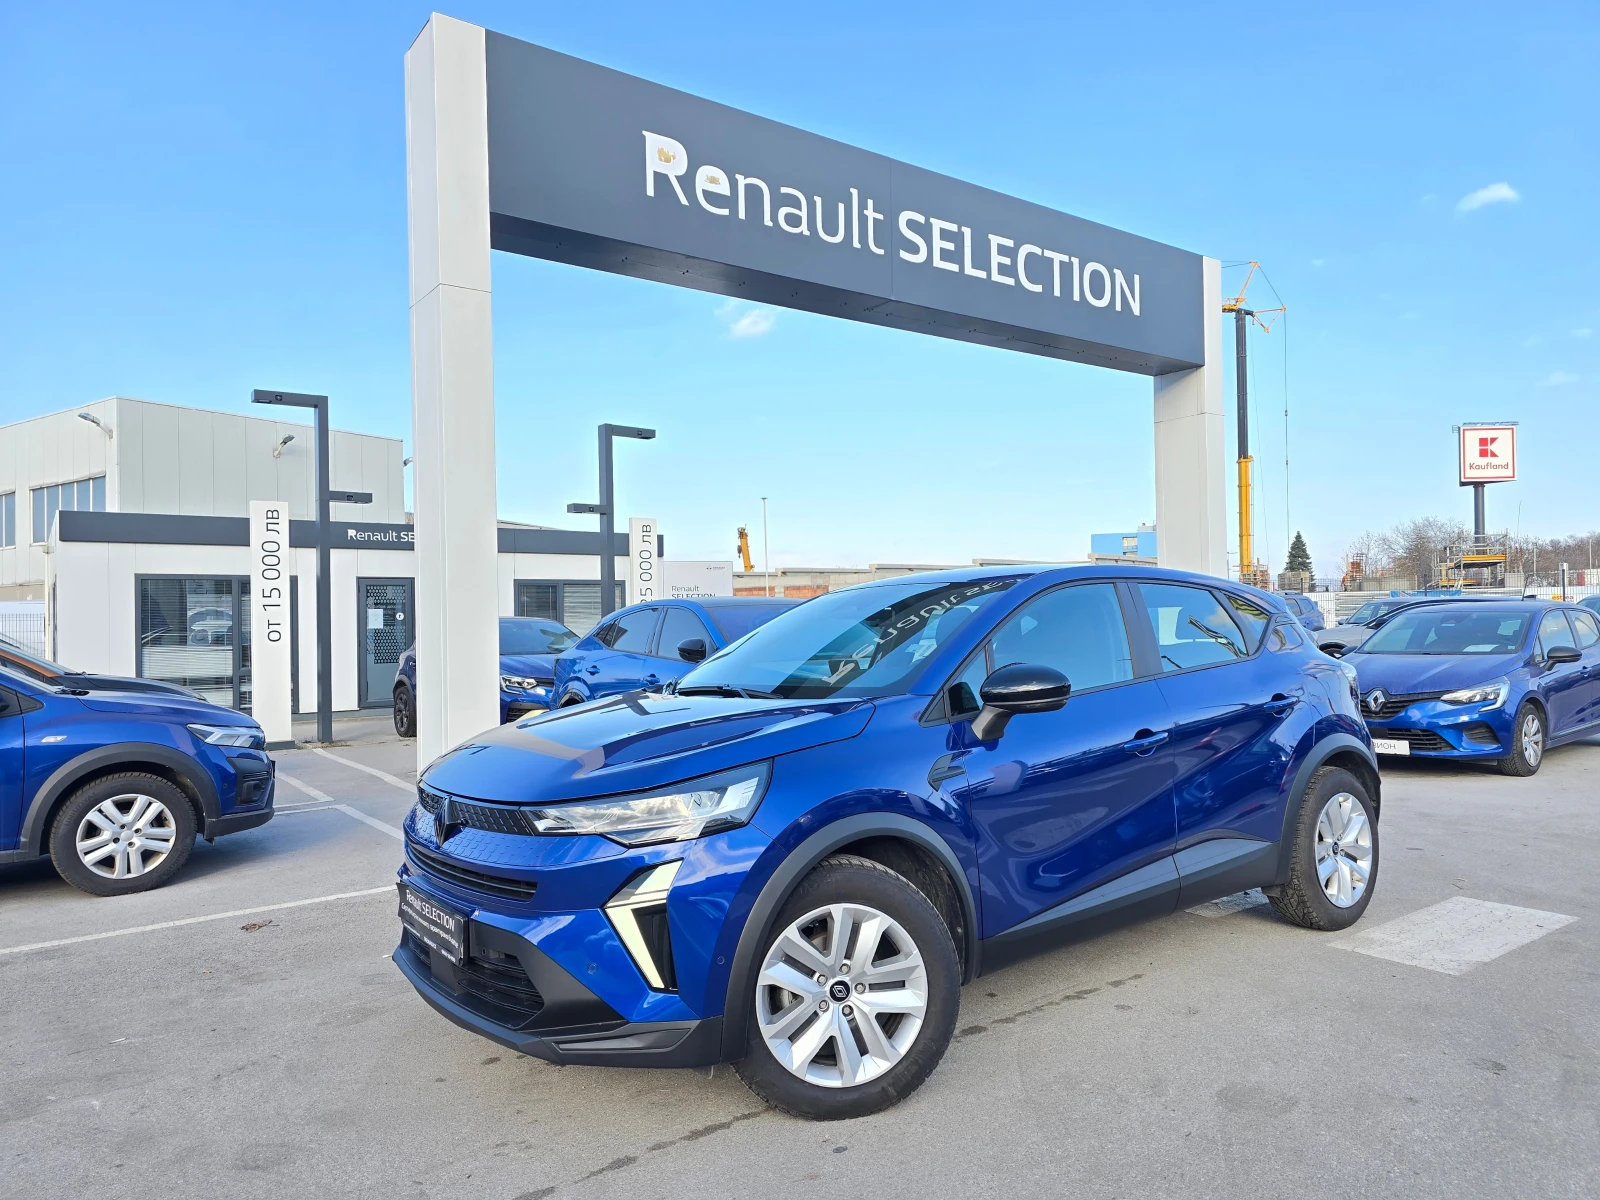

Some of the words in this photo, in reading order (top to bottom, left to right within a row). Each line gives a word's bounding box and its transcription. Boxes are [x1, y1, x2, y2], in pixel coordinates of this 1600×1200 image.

[642, 130, 885, 255] Renault
[898, 210, 1141, 316] SELECTION
[1469, 462, 1509, 470] Kaufland
[347, 529, 398, 541] Renault
[261, 540, 281, 580] 000
[639, 549, 652, 581] 000
[262, 587, 281, 611] 15
[421, 902, 455, 932] SELECTION
